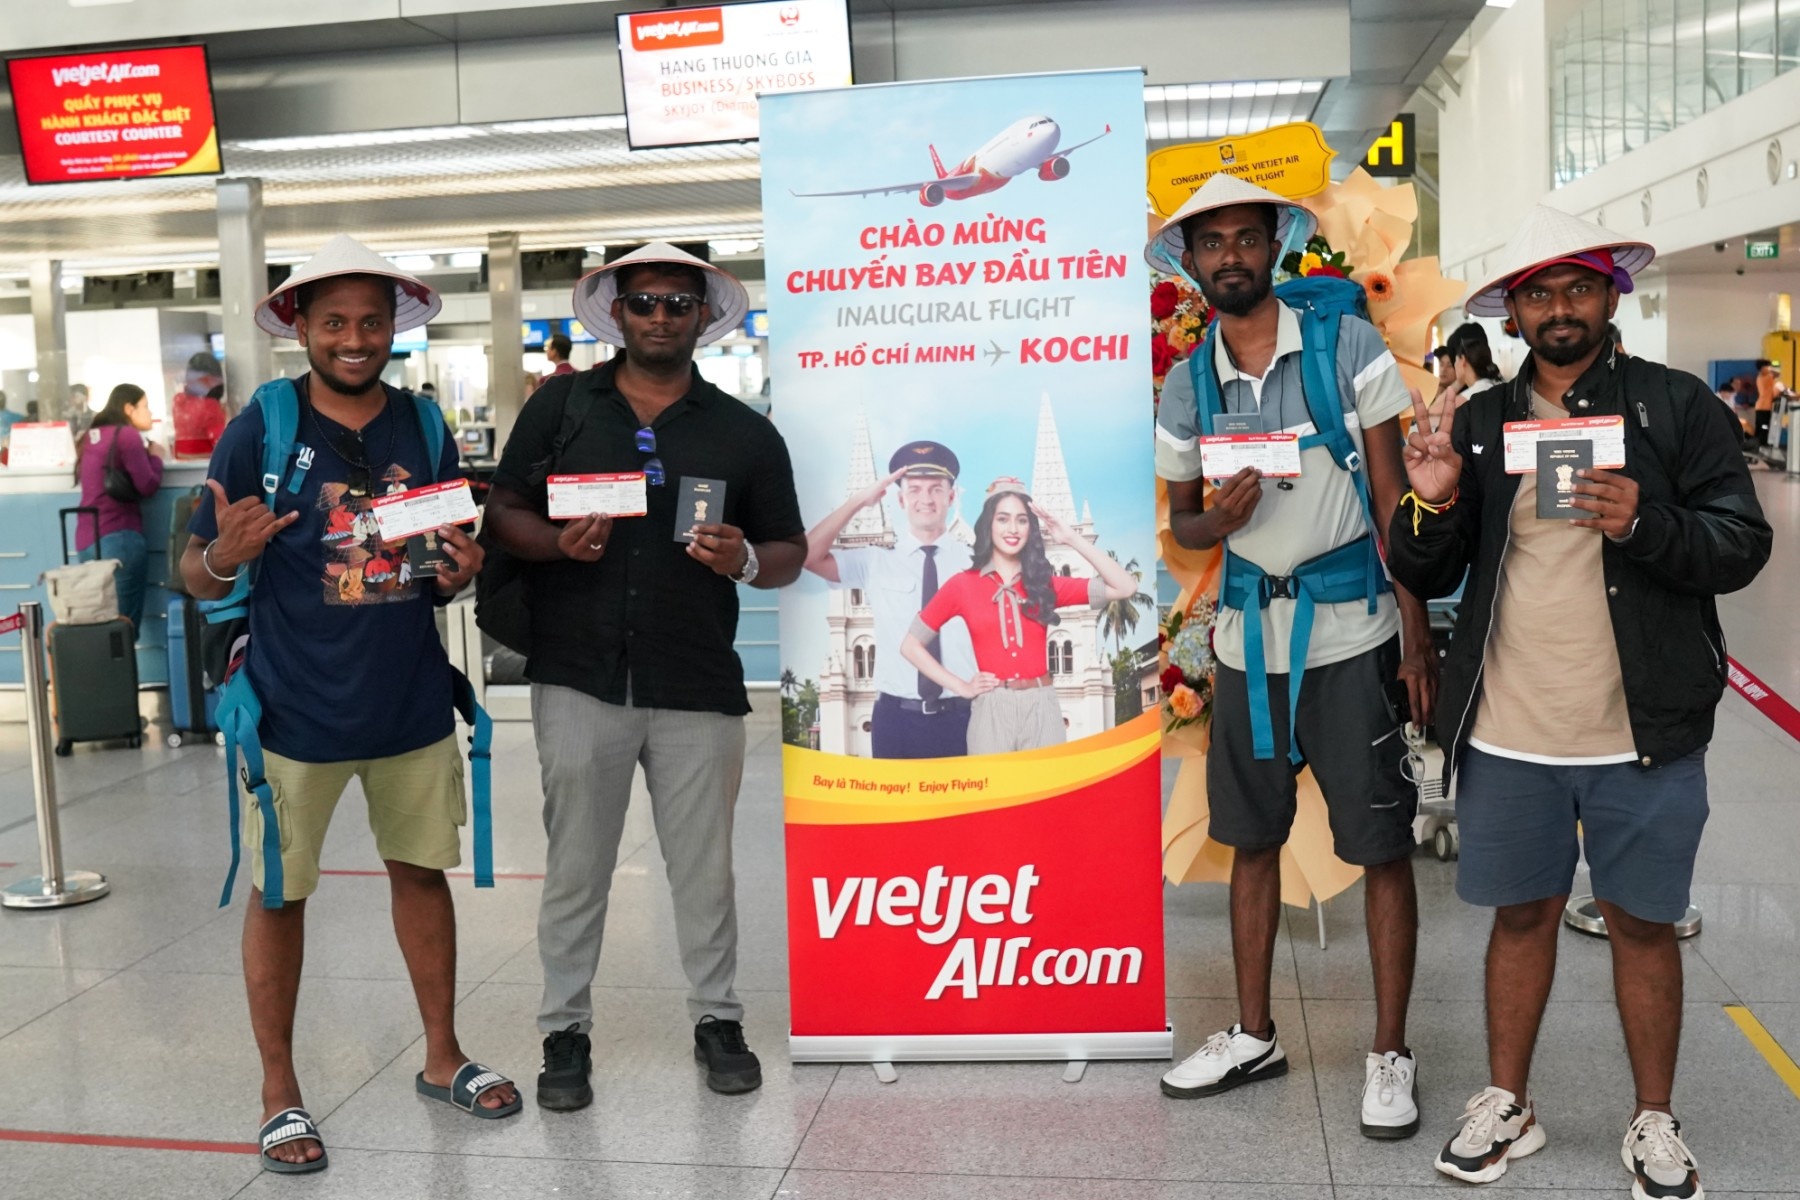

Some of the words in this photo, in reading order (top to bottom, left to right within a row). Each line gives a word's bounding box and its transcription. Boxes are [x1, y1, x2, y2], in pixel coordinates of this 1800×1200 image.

[785, 50, 813, 65] GIA
[104, 94, 140, 112] PHỤC
[143, 92, 162, 109] VỤ
[83, 110, 129, 128] KHÁCH
[162, 105, 191, 125] BIỆT
[55, 130, 118, 145] COURTESY
[122, 125, 182, 141] COUNTER
[1368, 121, 1403, 165] H
[1252, 159, 1283, 171] VIETJET
[1285, 155, 1300, 164] AIR
[1255, 170, 1285, 182] FLIGHT
[860, 218, 945, 250] CHÀO
[953, 213, 1047, 246] MỪNG
[786, 254, 906, 294] CHUYẾN
[915, 261, 977, 287] BAY
[983, 248, 1049, 284] ĐẦU
[1057, 248, 1127, 280] TIÊN
[836, 301, 982, 328] INAUGURAL
[988, 296, 1076, 321] FLIGHT
[798, 351, 828, 369] TP.
[834, 342, 868, 368] HỒ
[871, 342, 910, 365] CHÍ
[915, 344, 975, 363] MINH
[1019, 334, 1130, 364] KOCHI
[813, 774, 834, 789] Bay
[836, 777, 846, 789] là
[849, 778, 877, 791] Thích
[880, 782, 911, 795] ngay!
[919, 781, 949, 793] Enjoy
[951, 777, 988, 791] Flying!
[465, 1072, 503, 1094] PUMA
[262, 1121, 307, 1147] PUMA
